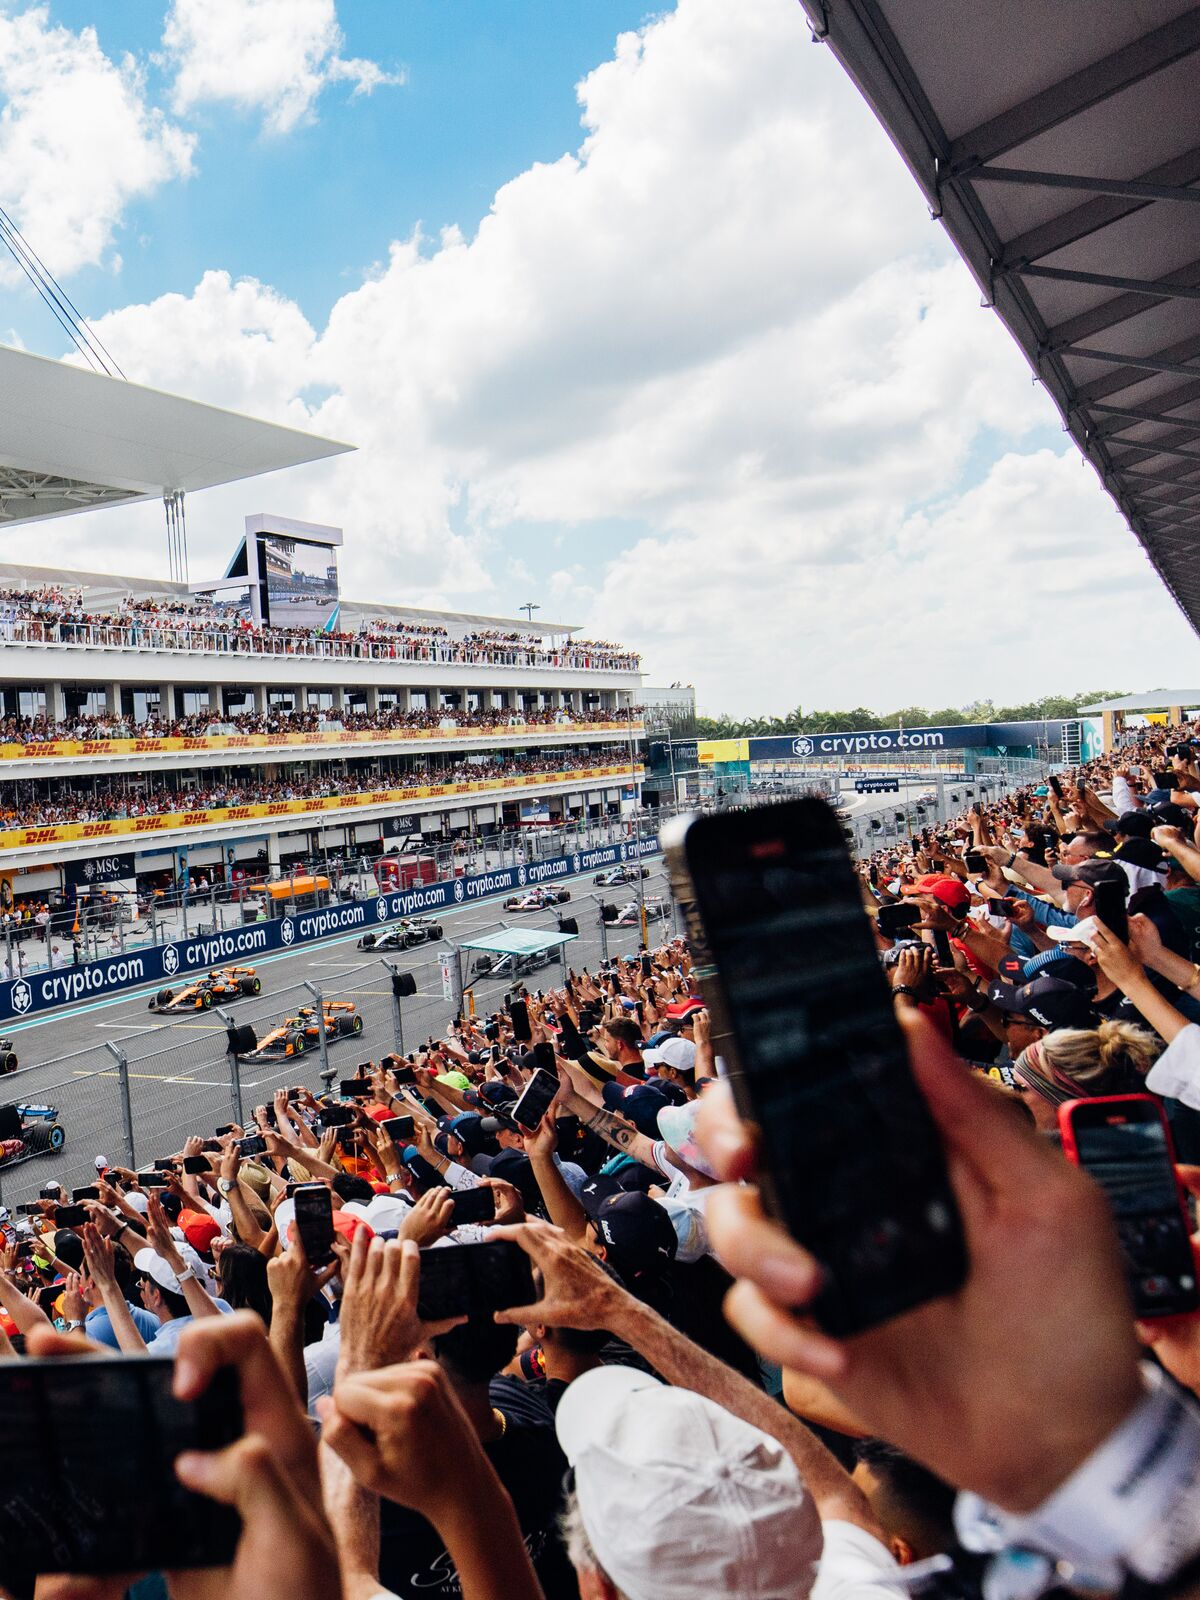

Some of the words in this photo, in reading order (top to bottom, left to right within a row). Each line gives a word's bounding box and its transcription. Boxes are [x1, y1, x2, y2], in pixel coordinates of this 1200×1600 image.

[82, 742, 112, 754] DHL
[135, 740, 162, 751] DHL
[182, 738, 208, 749] DHL
[820, 731, 944, 753] crypto.com
[24, 743, 56, 756] DHL
[864, 781, 897, 789] crypto.com
[268, 803, 290, 814] DHL
[305, 800, 325, 811] DHL
[340, 797, 358, 806] DHL
[184, 812, 210, 825] DHL
[228, 807, 254, 819] DHL
[82, 823, 114, 837] DHL
[135, 817, 163, 831] DHL
[24, 829, 59, 844] DHL
[582, 848, 616, 868] crypto.com
[96, 857, 120, 874] MSC
[529, 860, 568, 881] crypto.com
[467, 873, 512, 899] crypto.com
[392, 887, 445, 916] crypto.com
[300, 905, 365, 938] crypto.com
[186, 926, 267, 966] crypto.com
[42, 957, 144, 1001] crypto.com
